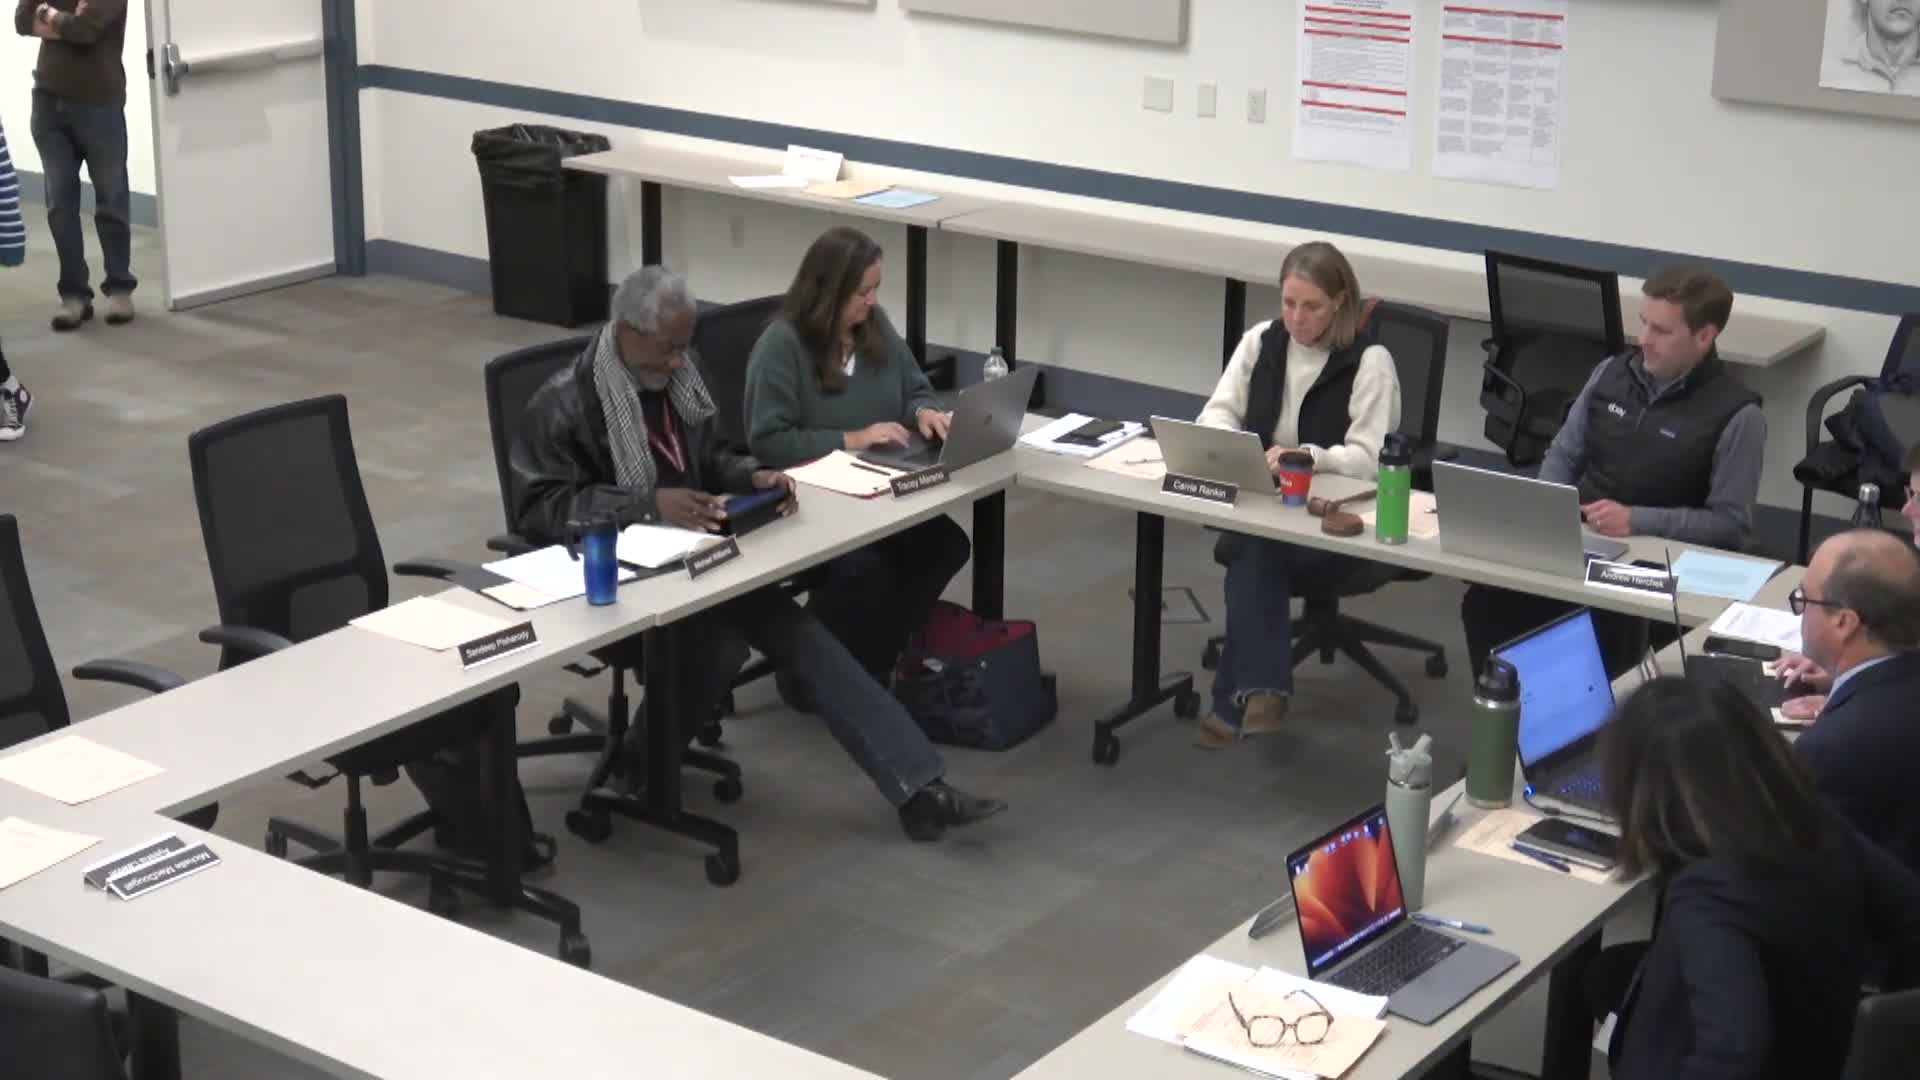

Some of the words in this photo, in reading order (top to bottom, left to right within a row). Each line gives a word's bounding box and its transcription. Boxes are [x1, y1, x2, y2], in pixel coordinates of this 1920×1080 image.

[1173, 480, 1198, 492] Carrie
[1199, 485, 1226, 498] Rankin
[1600, 570, 1630, 582] Andrew
